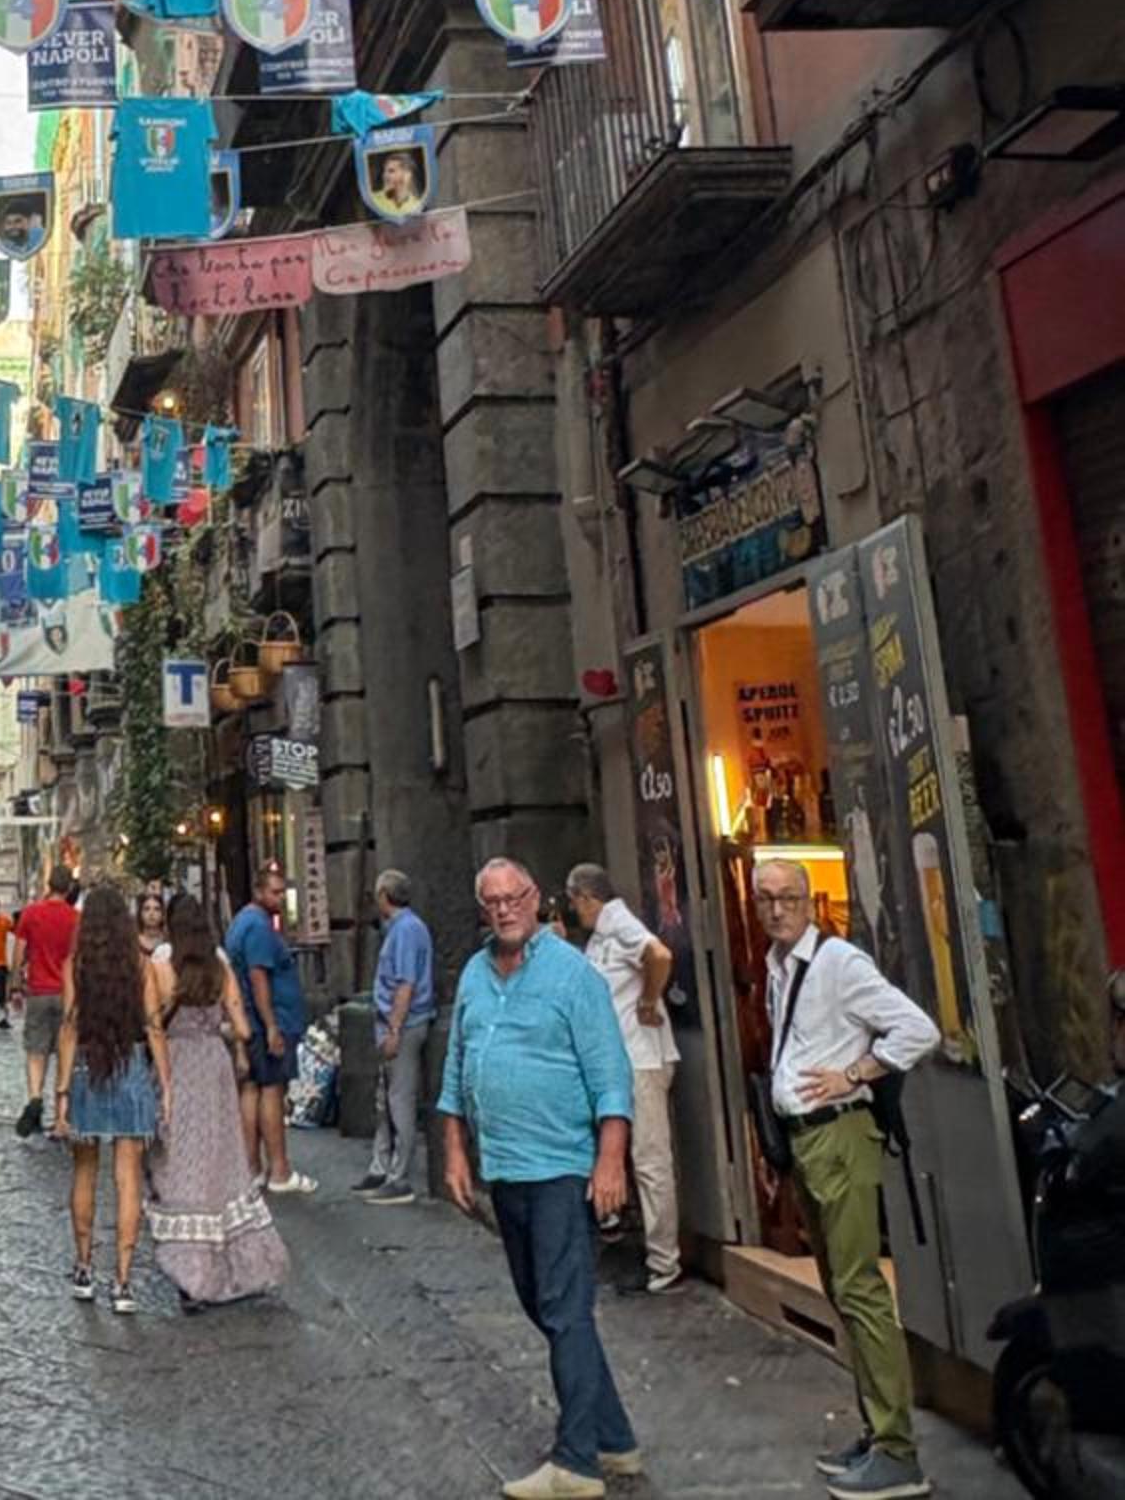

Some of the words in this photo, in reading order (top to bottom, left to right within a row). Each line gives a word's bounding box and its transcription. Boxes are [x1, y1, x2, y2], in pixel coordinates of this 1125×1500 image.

[43, 30, 104, 48] EVER
[310, 26, 344, 44] OLI
[32, 47, 109, 66] NAPOLI
[167, 664, 206, 705] T
